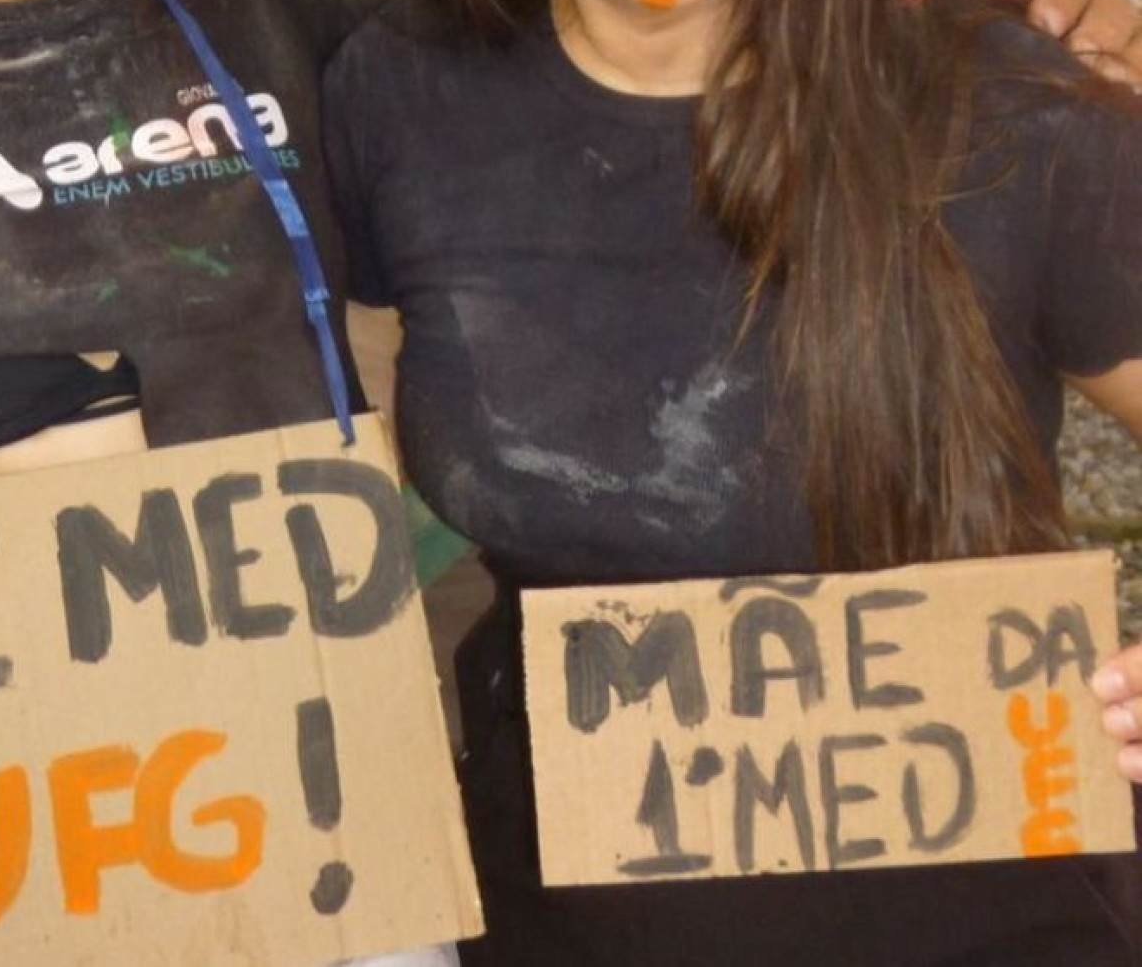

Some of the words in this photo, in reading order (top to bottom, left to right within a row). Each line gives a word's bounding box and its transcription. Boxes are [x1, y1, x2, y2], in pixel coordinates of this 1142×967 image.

[53, 177, 131, 206] ENEM
[136, 147, 301, 191] VESTIBULES
[54, 458, 412, 663] MED
[560, 575, 929, 733] MÃE
[986, 599, 1097, 689] DA
